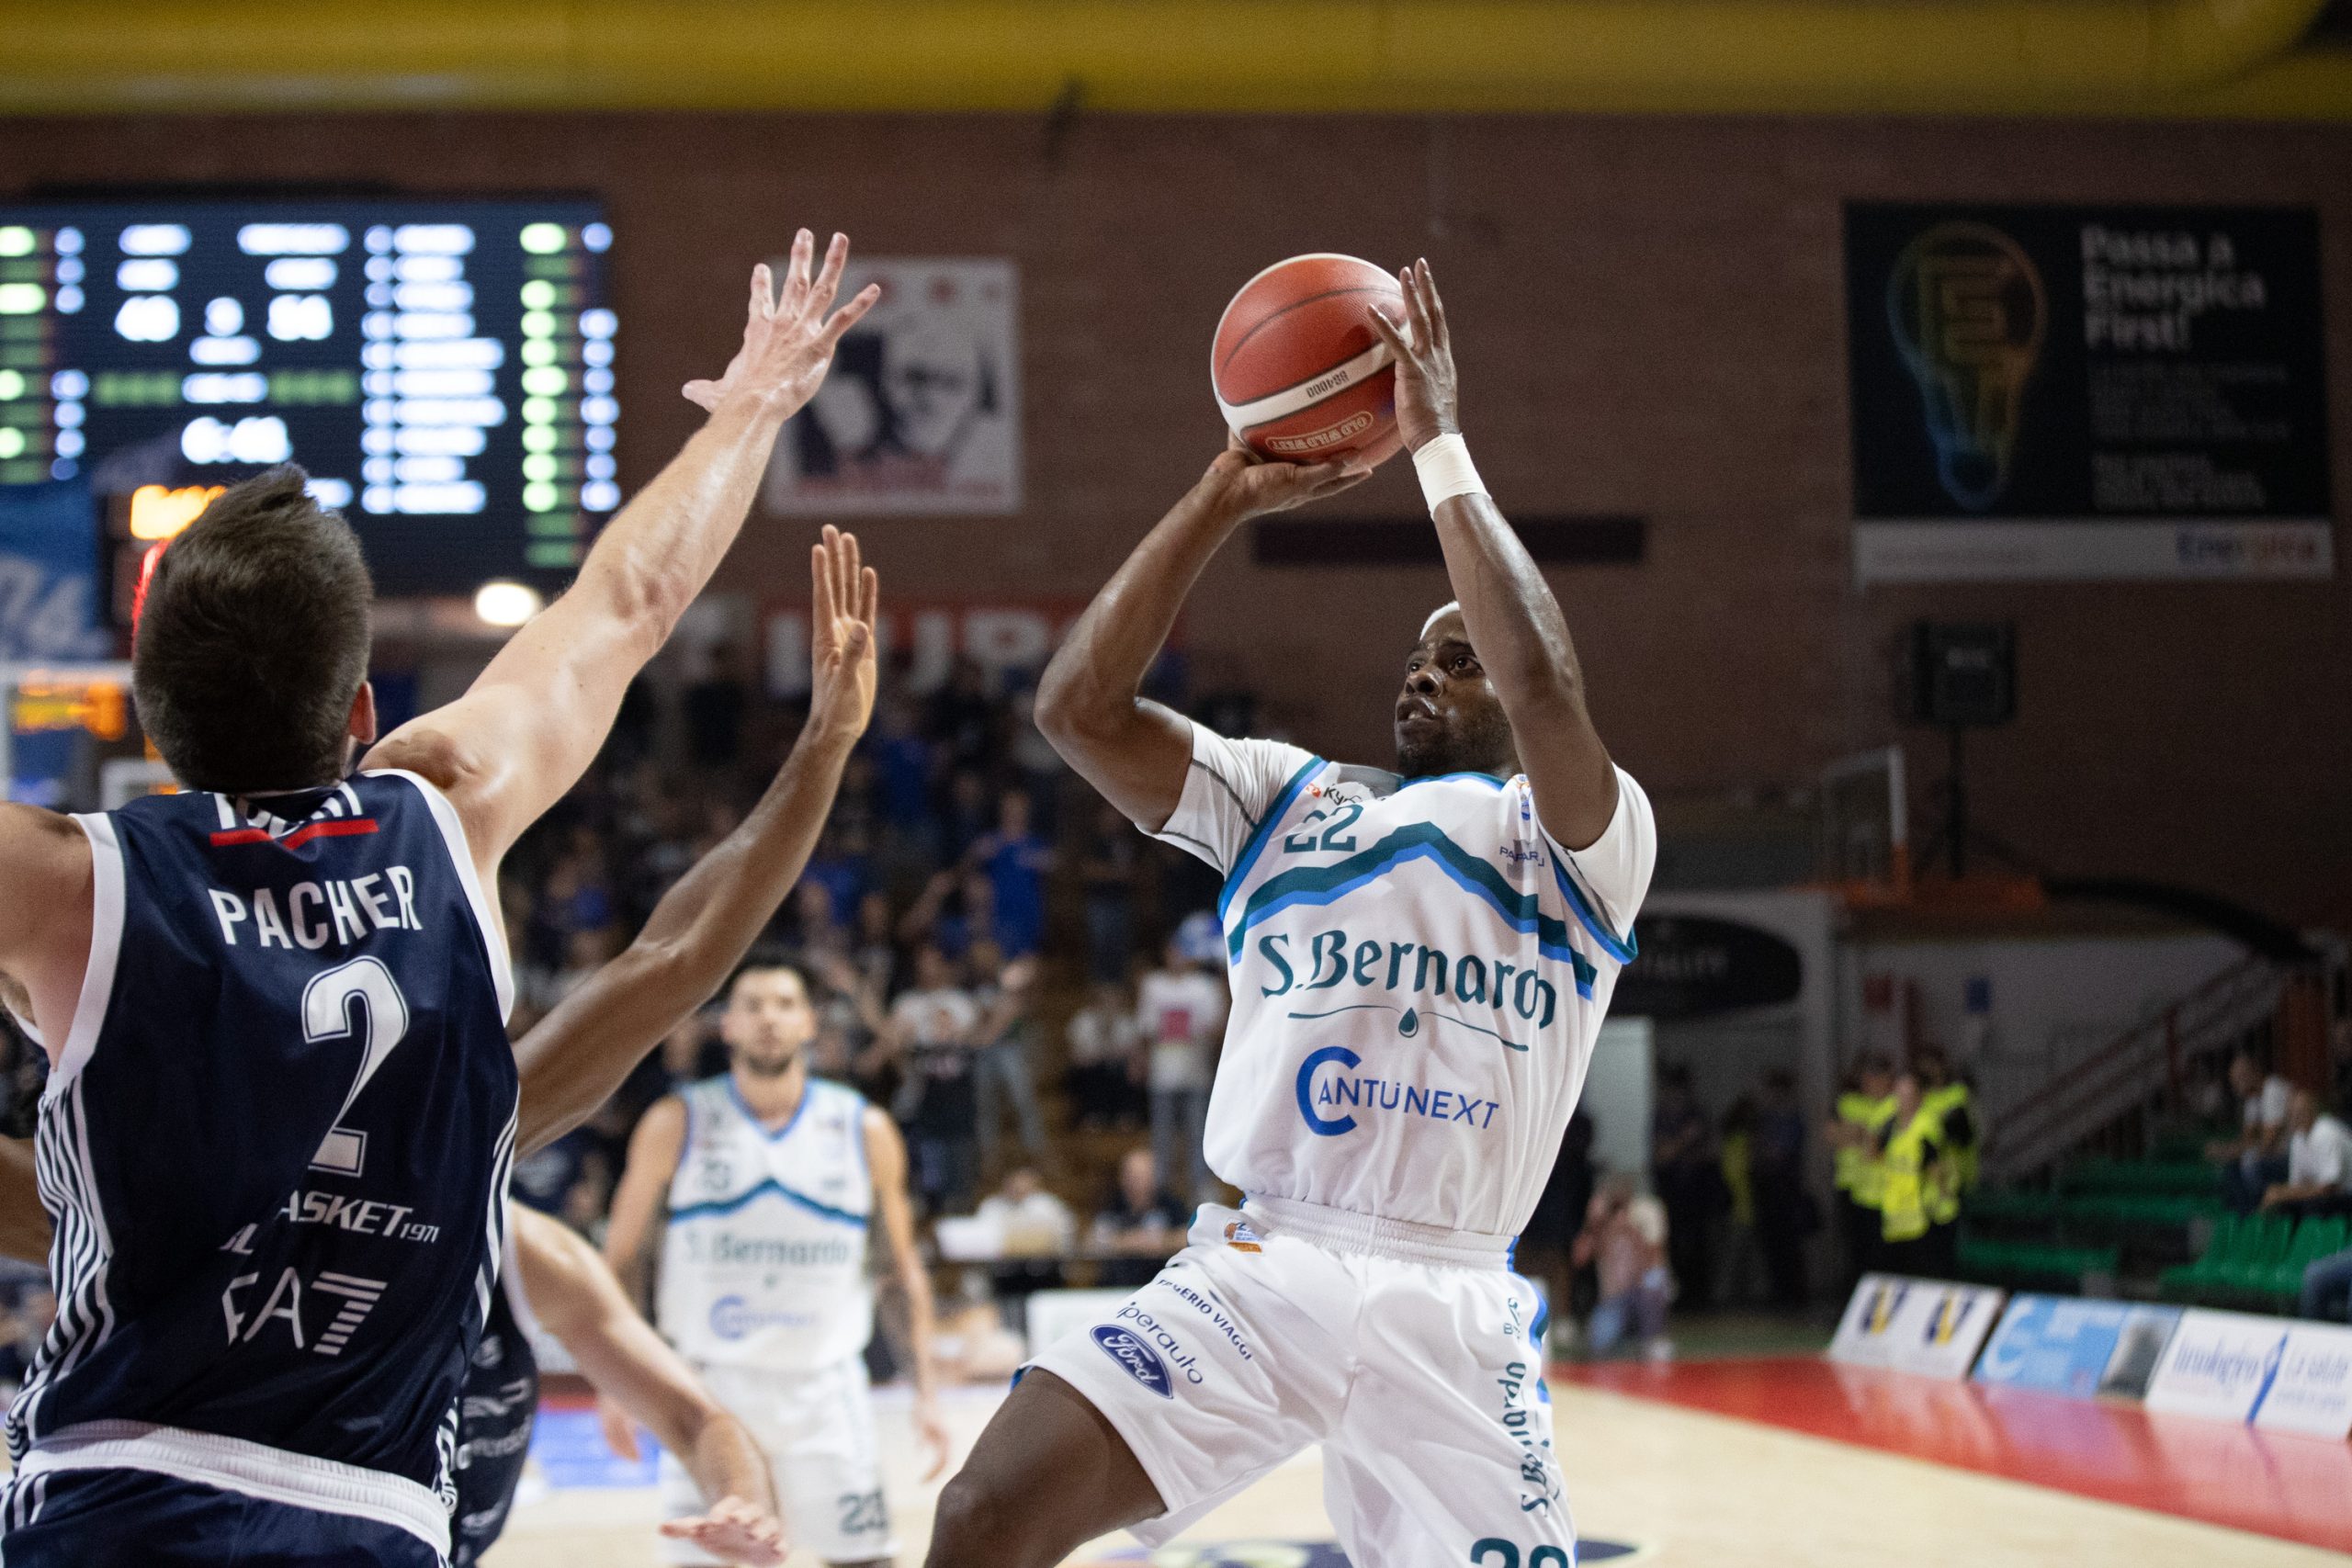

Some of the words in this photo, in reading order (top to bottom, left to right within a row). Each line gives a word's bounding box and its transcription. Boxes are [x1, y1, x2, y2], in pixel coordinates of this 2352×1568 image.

[1283, 804, 1363, 853] 22
[208, 865, 424, 950] PACHER
[301, 954, 409, 1179] 2
[1102, 1333, 1160, 1385] Ford
[1115, 1301, 1204, 1384] iperauto
[1213, 1313, 1251, 1360] VIAGGI
